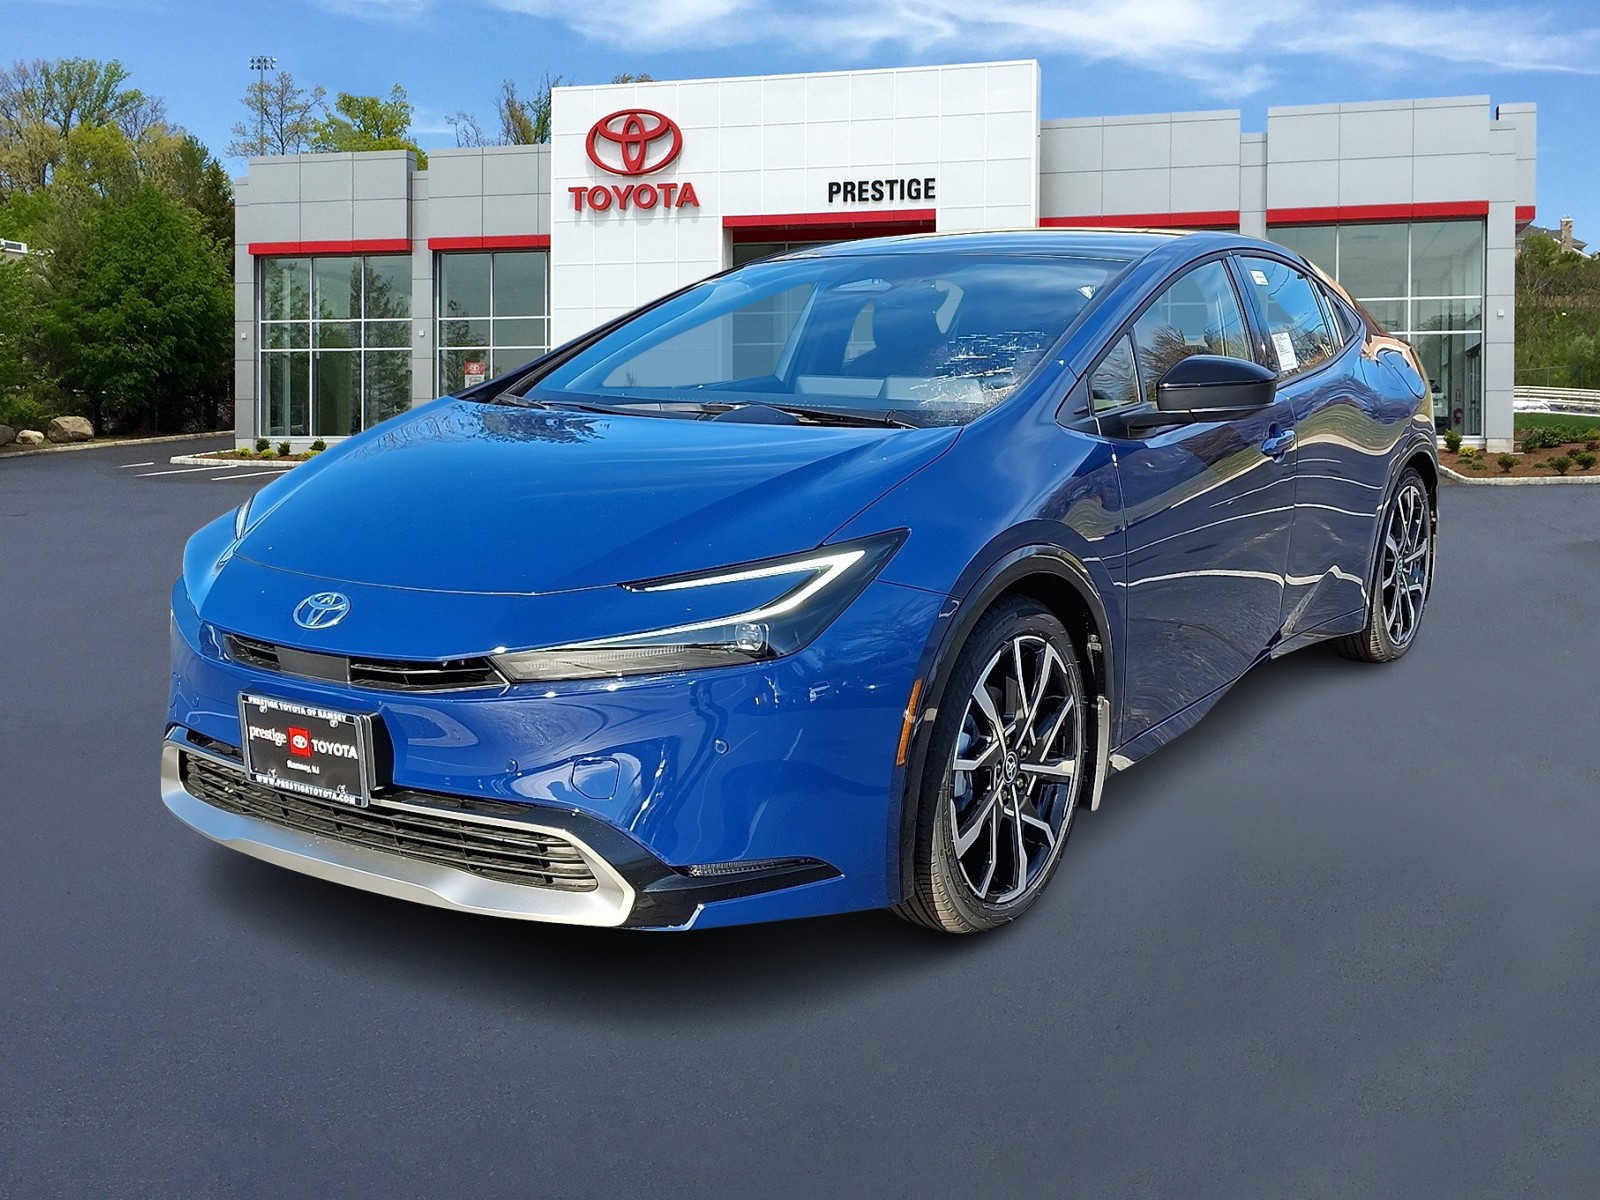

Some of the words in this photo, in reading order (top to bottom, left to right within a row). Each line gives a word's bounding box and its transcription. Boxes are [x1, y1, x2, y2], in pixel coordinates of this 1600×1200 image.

[568, 182, 700, 212] TOYOTA
[827, 177, 936, 203] PRESTIGE
[279, 702, 306, 715] TOYOTA
[249, 726, 287, 746] prestige
[311, 739, 358, 760] TOYOTA
